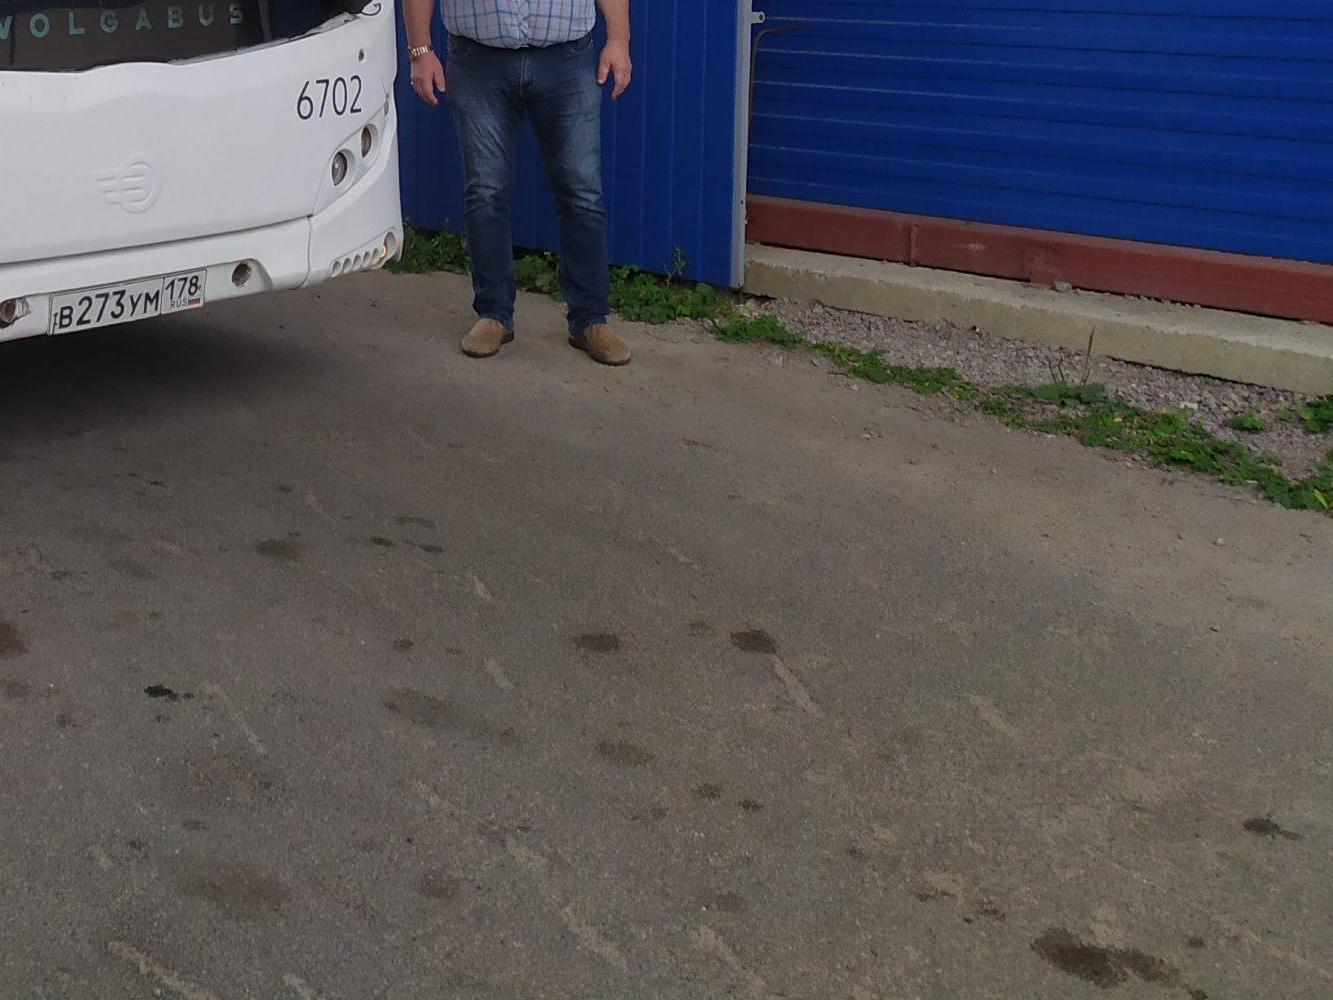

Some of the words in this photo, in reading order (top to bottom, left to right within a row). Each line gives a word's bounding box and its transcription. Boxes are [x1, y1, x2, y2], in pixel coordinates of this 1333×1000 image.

[296, 74, 363, 120] 6702
[58, 289, 160, 330] В273УМ
[165, 275, 199, 300] 178
